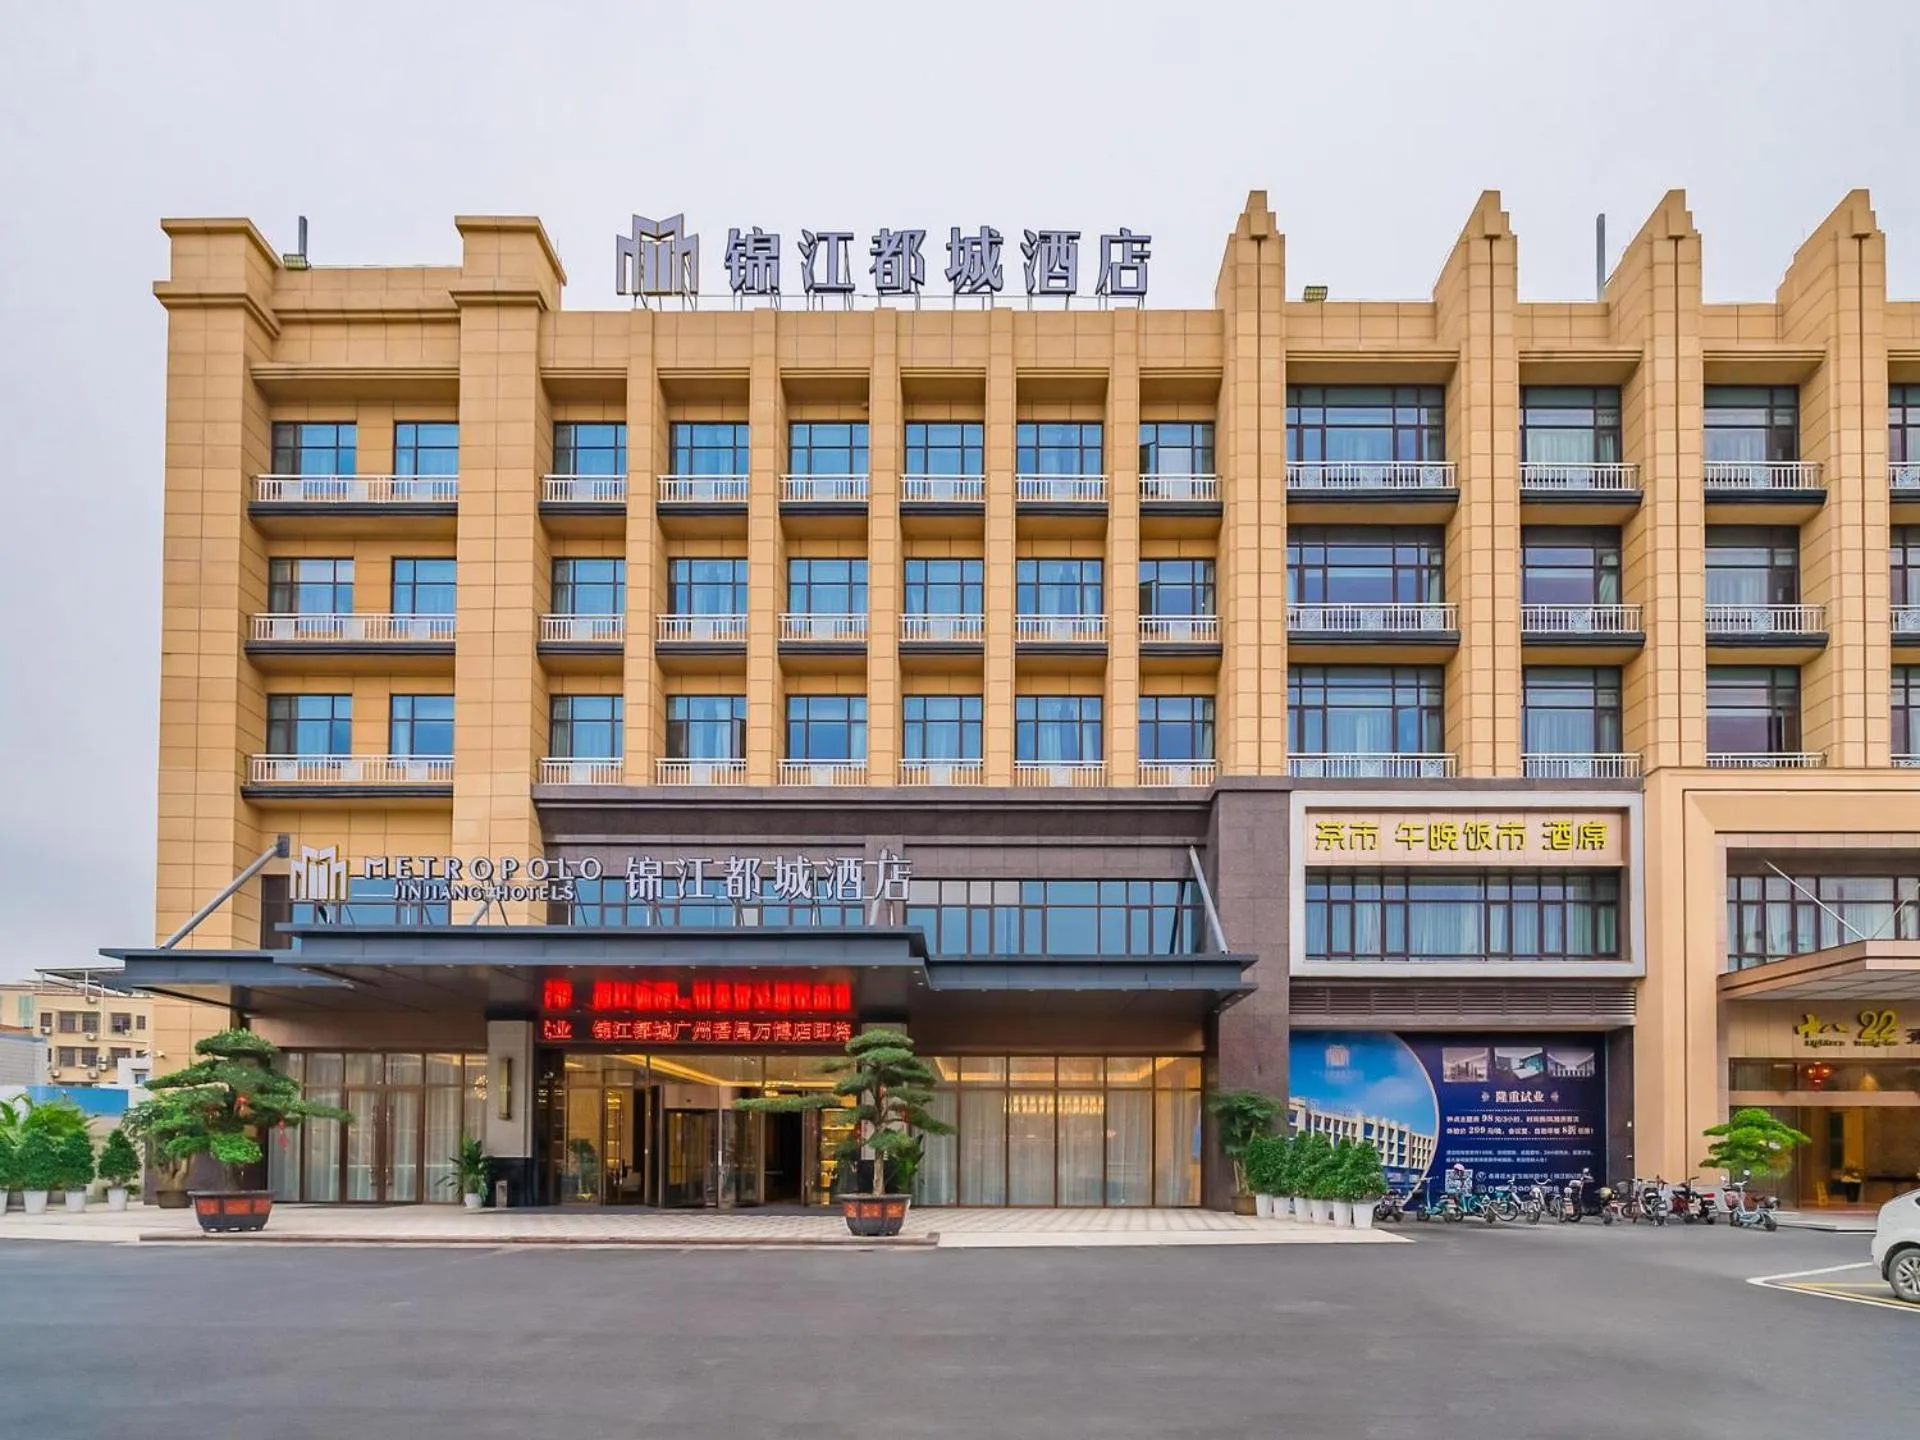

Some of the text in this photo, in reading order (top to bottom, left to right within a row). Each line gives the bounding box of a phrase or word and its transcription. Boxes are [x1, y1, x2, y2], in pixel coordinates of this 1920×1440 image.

[724, 225, 1152, 296] 锦江都城酒店
[1315, 820, 1607, 851] 茶市 午晚饭市 酒席
[364, 855, 602, 881] METROPOLO
[625, 854, 913, 900] 锦江都城酒店
[393, 880, 575, 901] JINJIANG HOTELS
